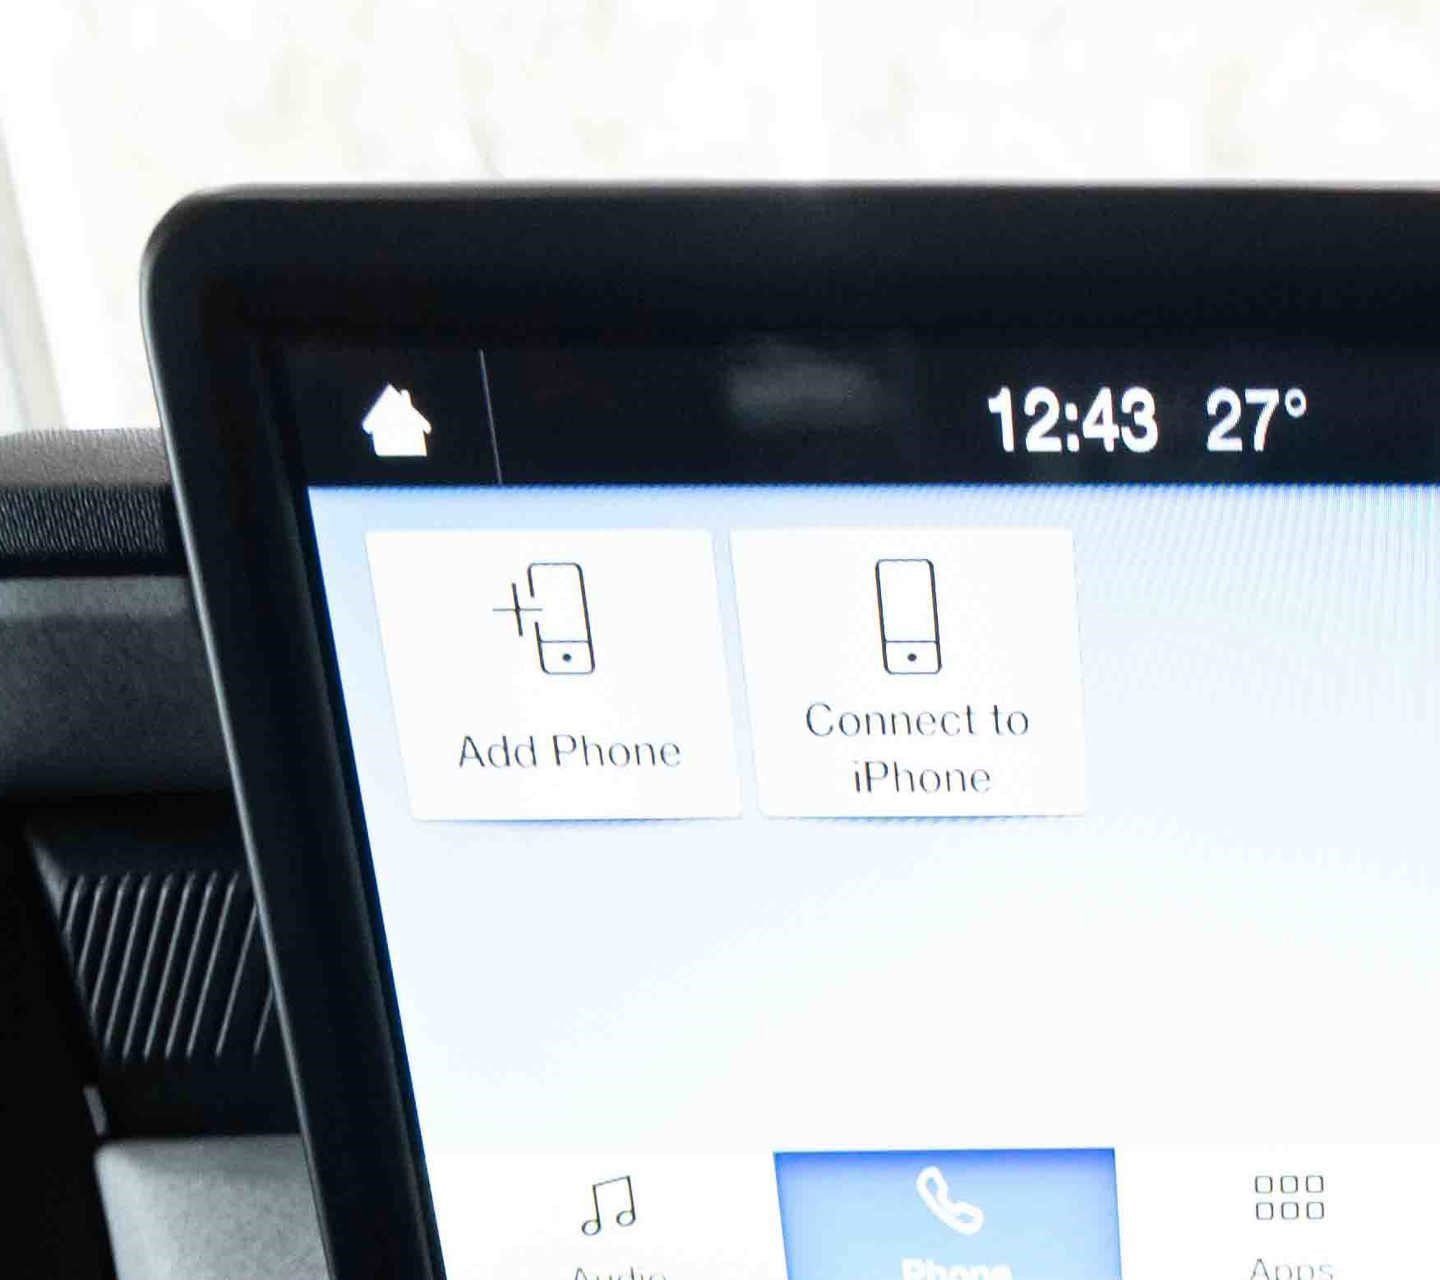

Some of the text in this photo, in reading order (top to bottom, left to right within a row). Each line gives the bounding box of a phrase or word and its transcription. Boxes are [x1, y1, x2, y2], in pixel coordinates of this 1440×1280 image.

[989, 387, 1306, 452] 12:43 27°
[806, 703, 1030, 738] Connect to
[460, 735, 679, 767] Add Phone
[853, 760, 993, 796] iPhone
